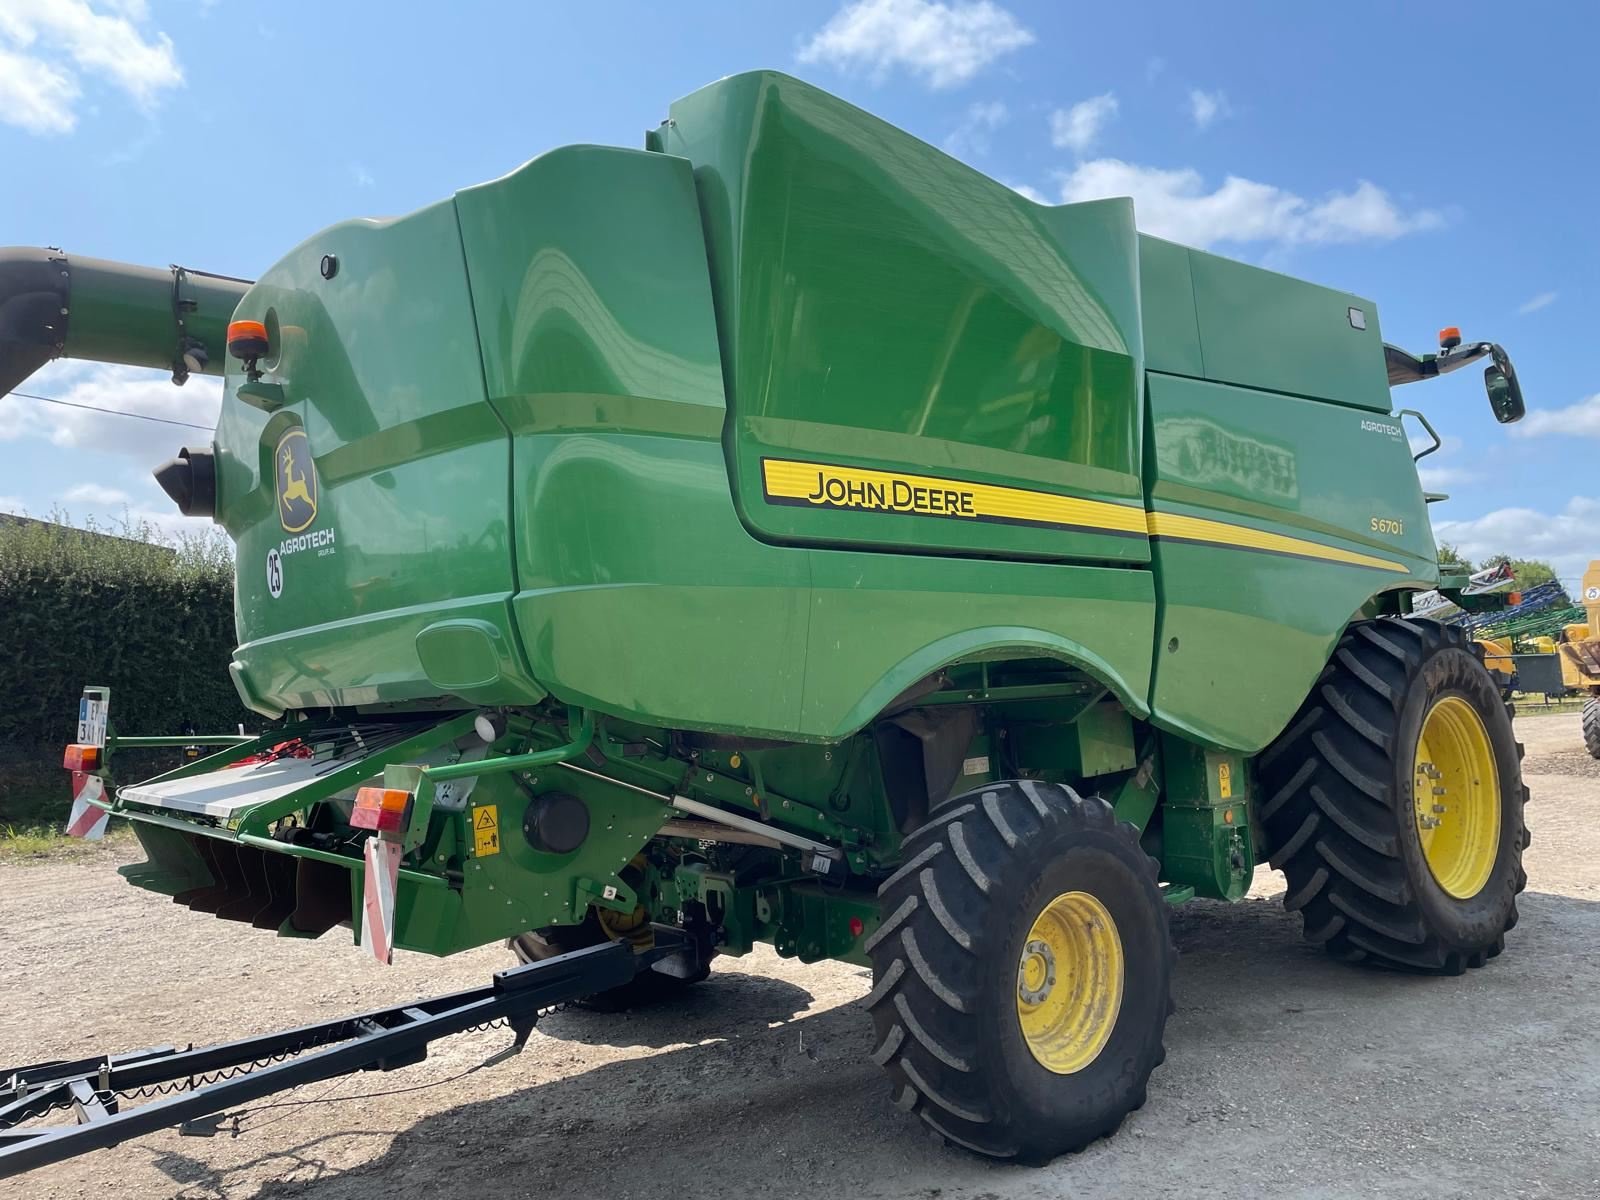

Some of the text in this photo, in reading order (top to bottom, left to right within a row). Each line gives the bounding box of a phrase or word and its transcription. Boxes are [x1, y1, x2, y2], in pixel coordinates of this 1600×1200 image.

[1360, 420, 1402, 436] AGROTECH
[808, 471, 976, 516] JOHN DEERE
[279, 527, 335, 556] AGROTECH
[269, 554, 281, 592] 25
